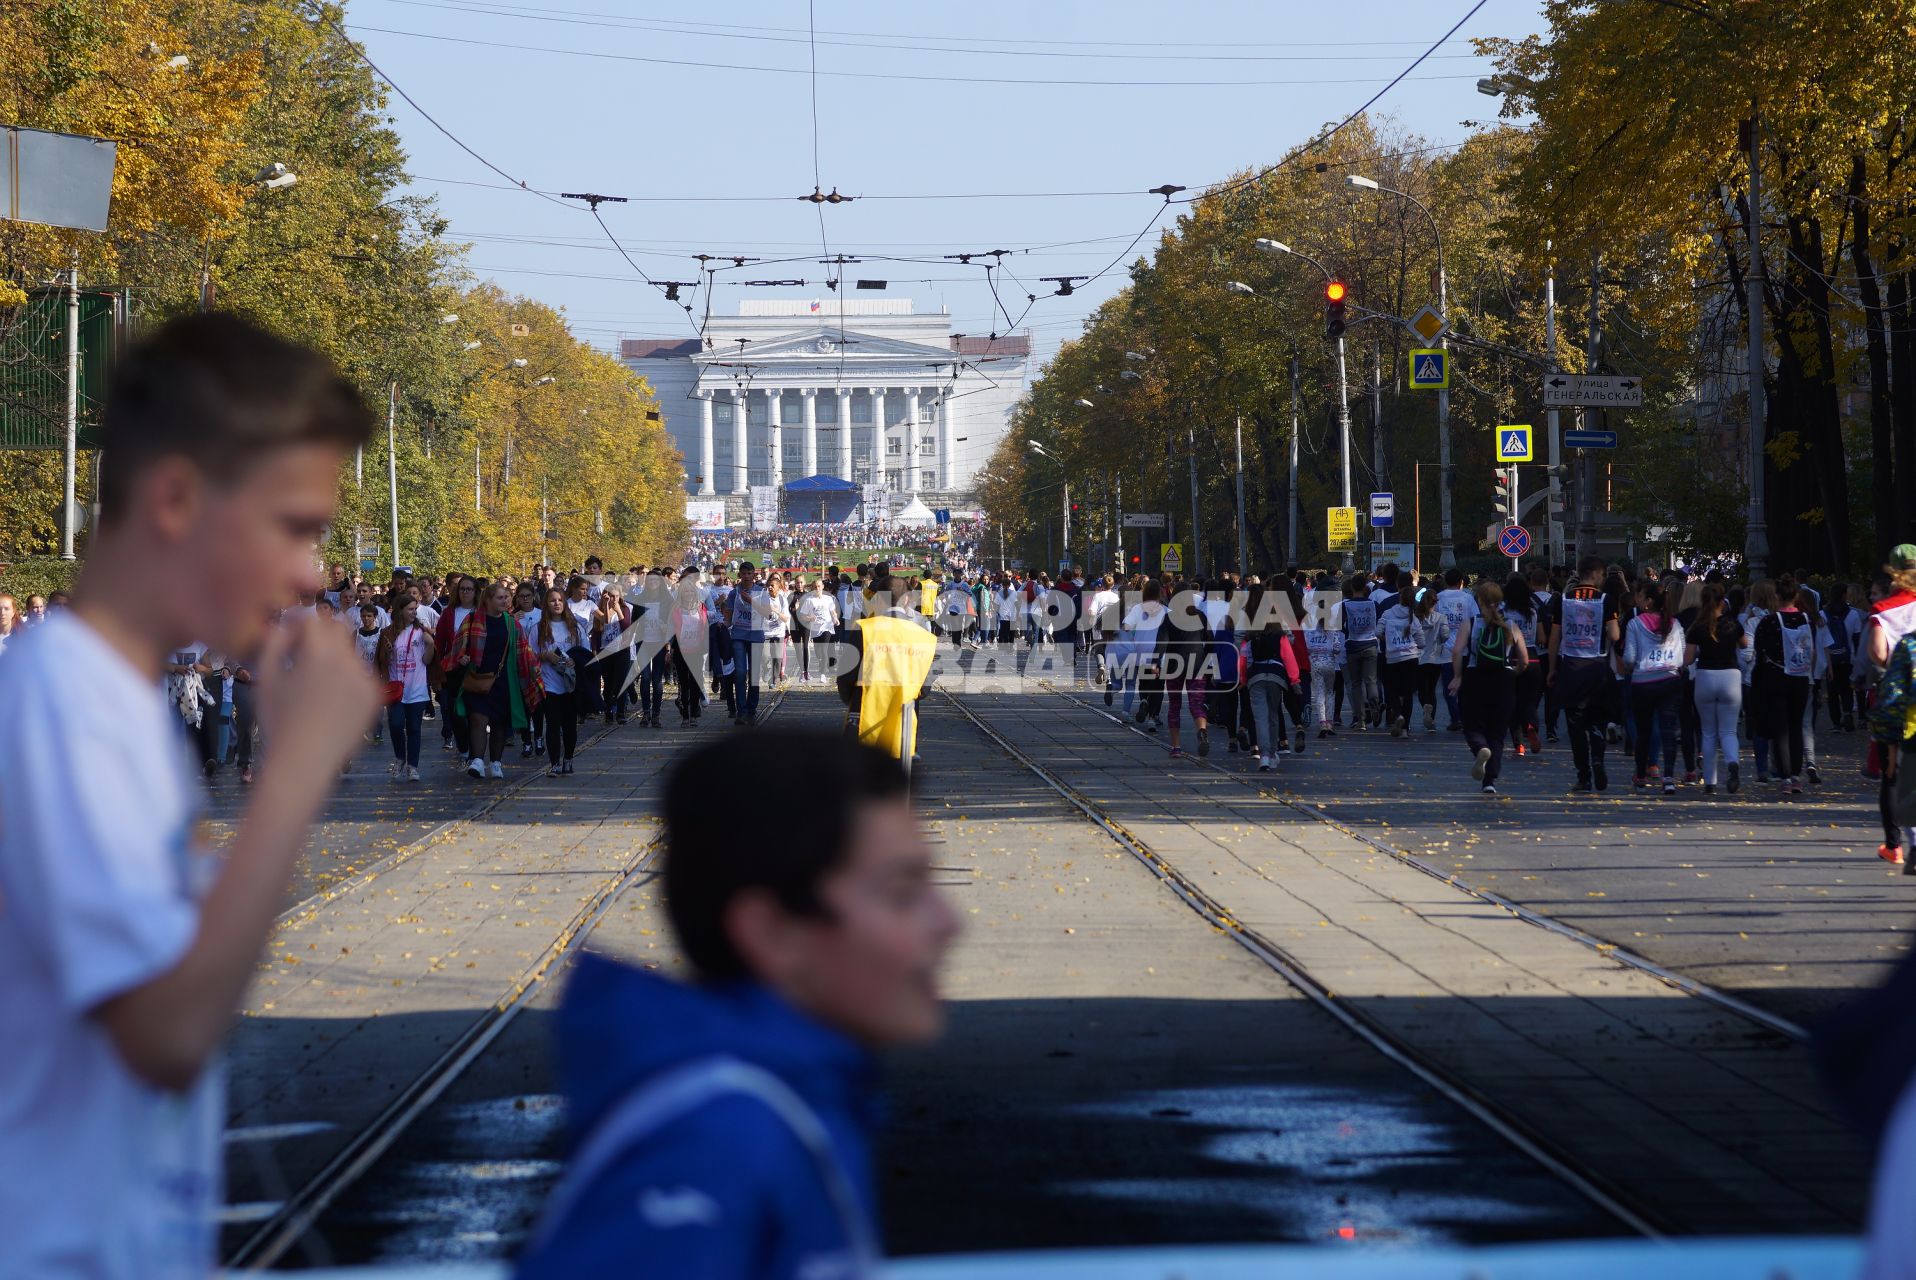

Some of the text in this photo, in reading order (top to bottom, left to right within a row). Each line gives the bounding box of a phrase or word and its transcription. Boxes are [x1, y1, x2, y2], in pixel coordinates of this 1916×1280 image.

[1577, 380, 1609, 389] улица
[1547, 391, 1638, 401] ГЕНЕРАЛЬСКАЯ
[1567, 623, 1598, 636] 20795
[1310, 636, 1328, 645] 4122
